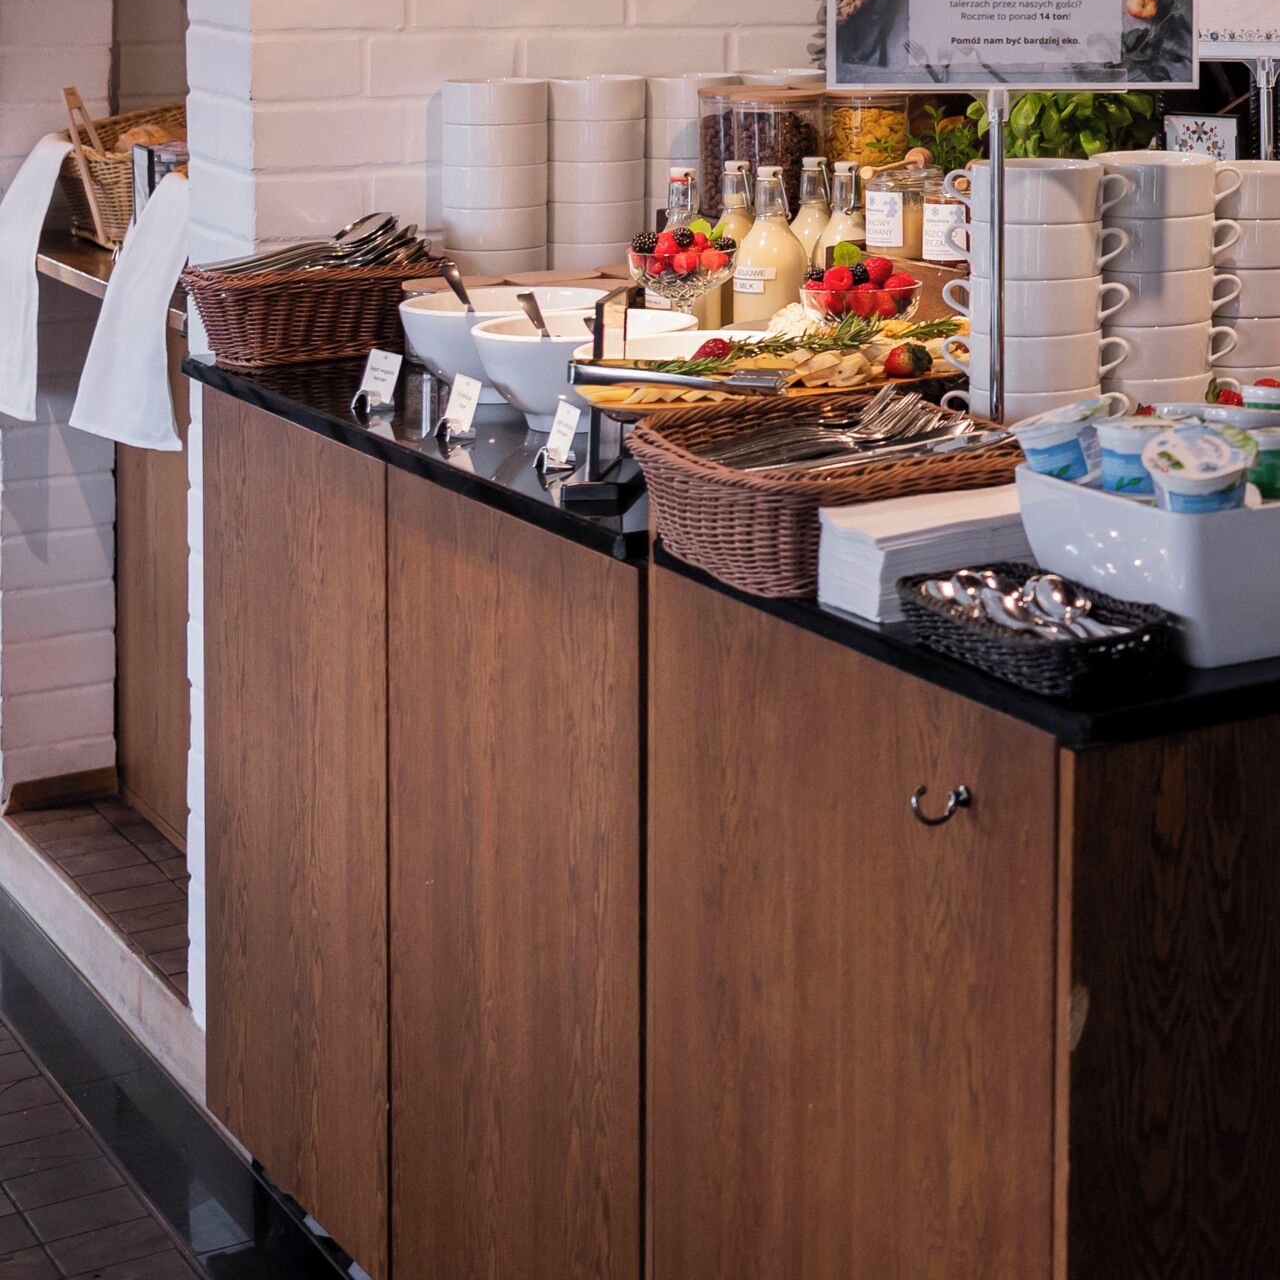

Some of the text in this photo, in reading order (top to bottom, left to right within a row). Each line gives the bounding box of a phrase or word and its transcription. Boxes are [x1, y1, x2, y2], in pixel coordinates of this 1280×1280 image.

[949, 0, 1083, 10] talerzach przez naszych gości?
[961, 12, 1071, 23] Rocznie to ponad 14 ton!
[951, 36, 981, 45] Pomóż
[1006, 36, 1021, 47] być
[1024, 36, 1060, 47] bardziej
[1062, 37, 1081, 45] eko.
